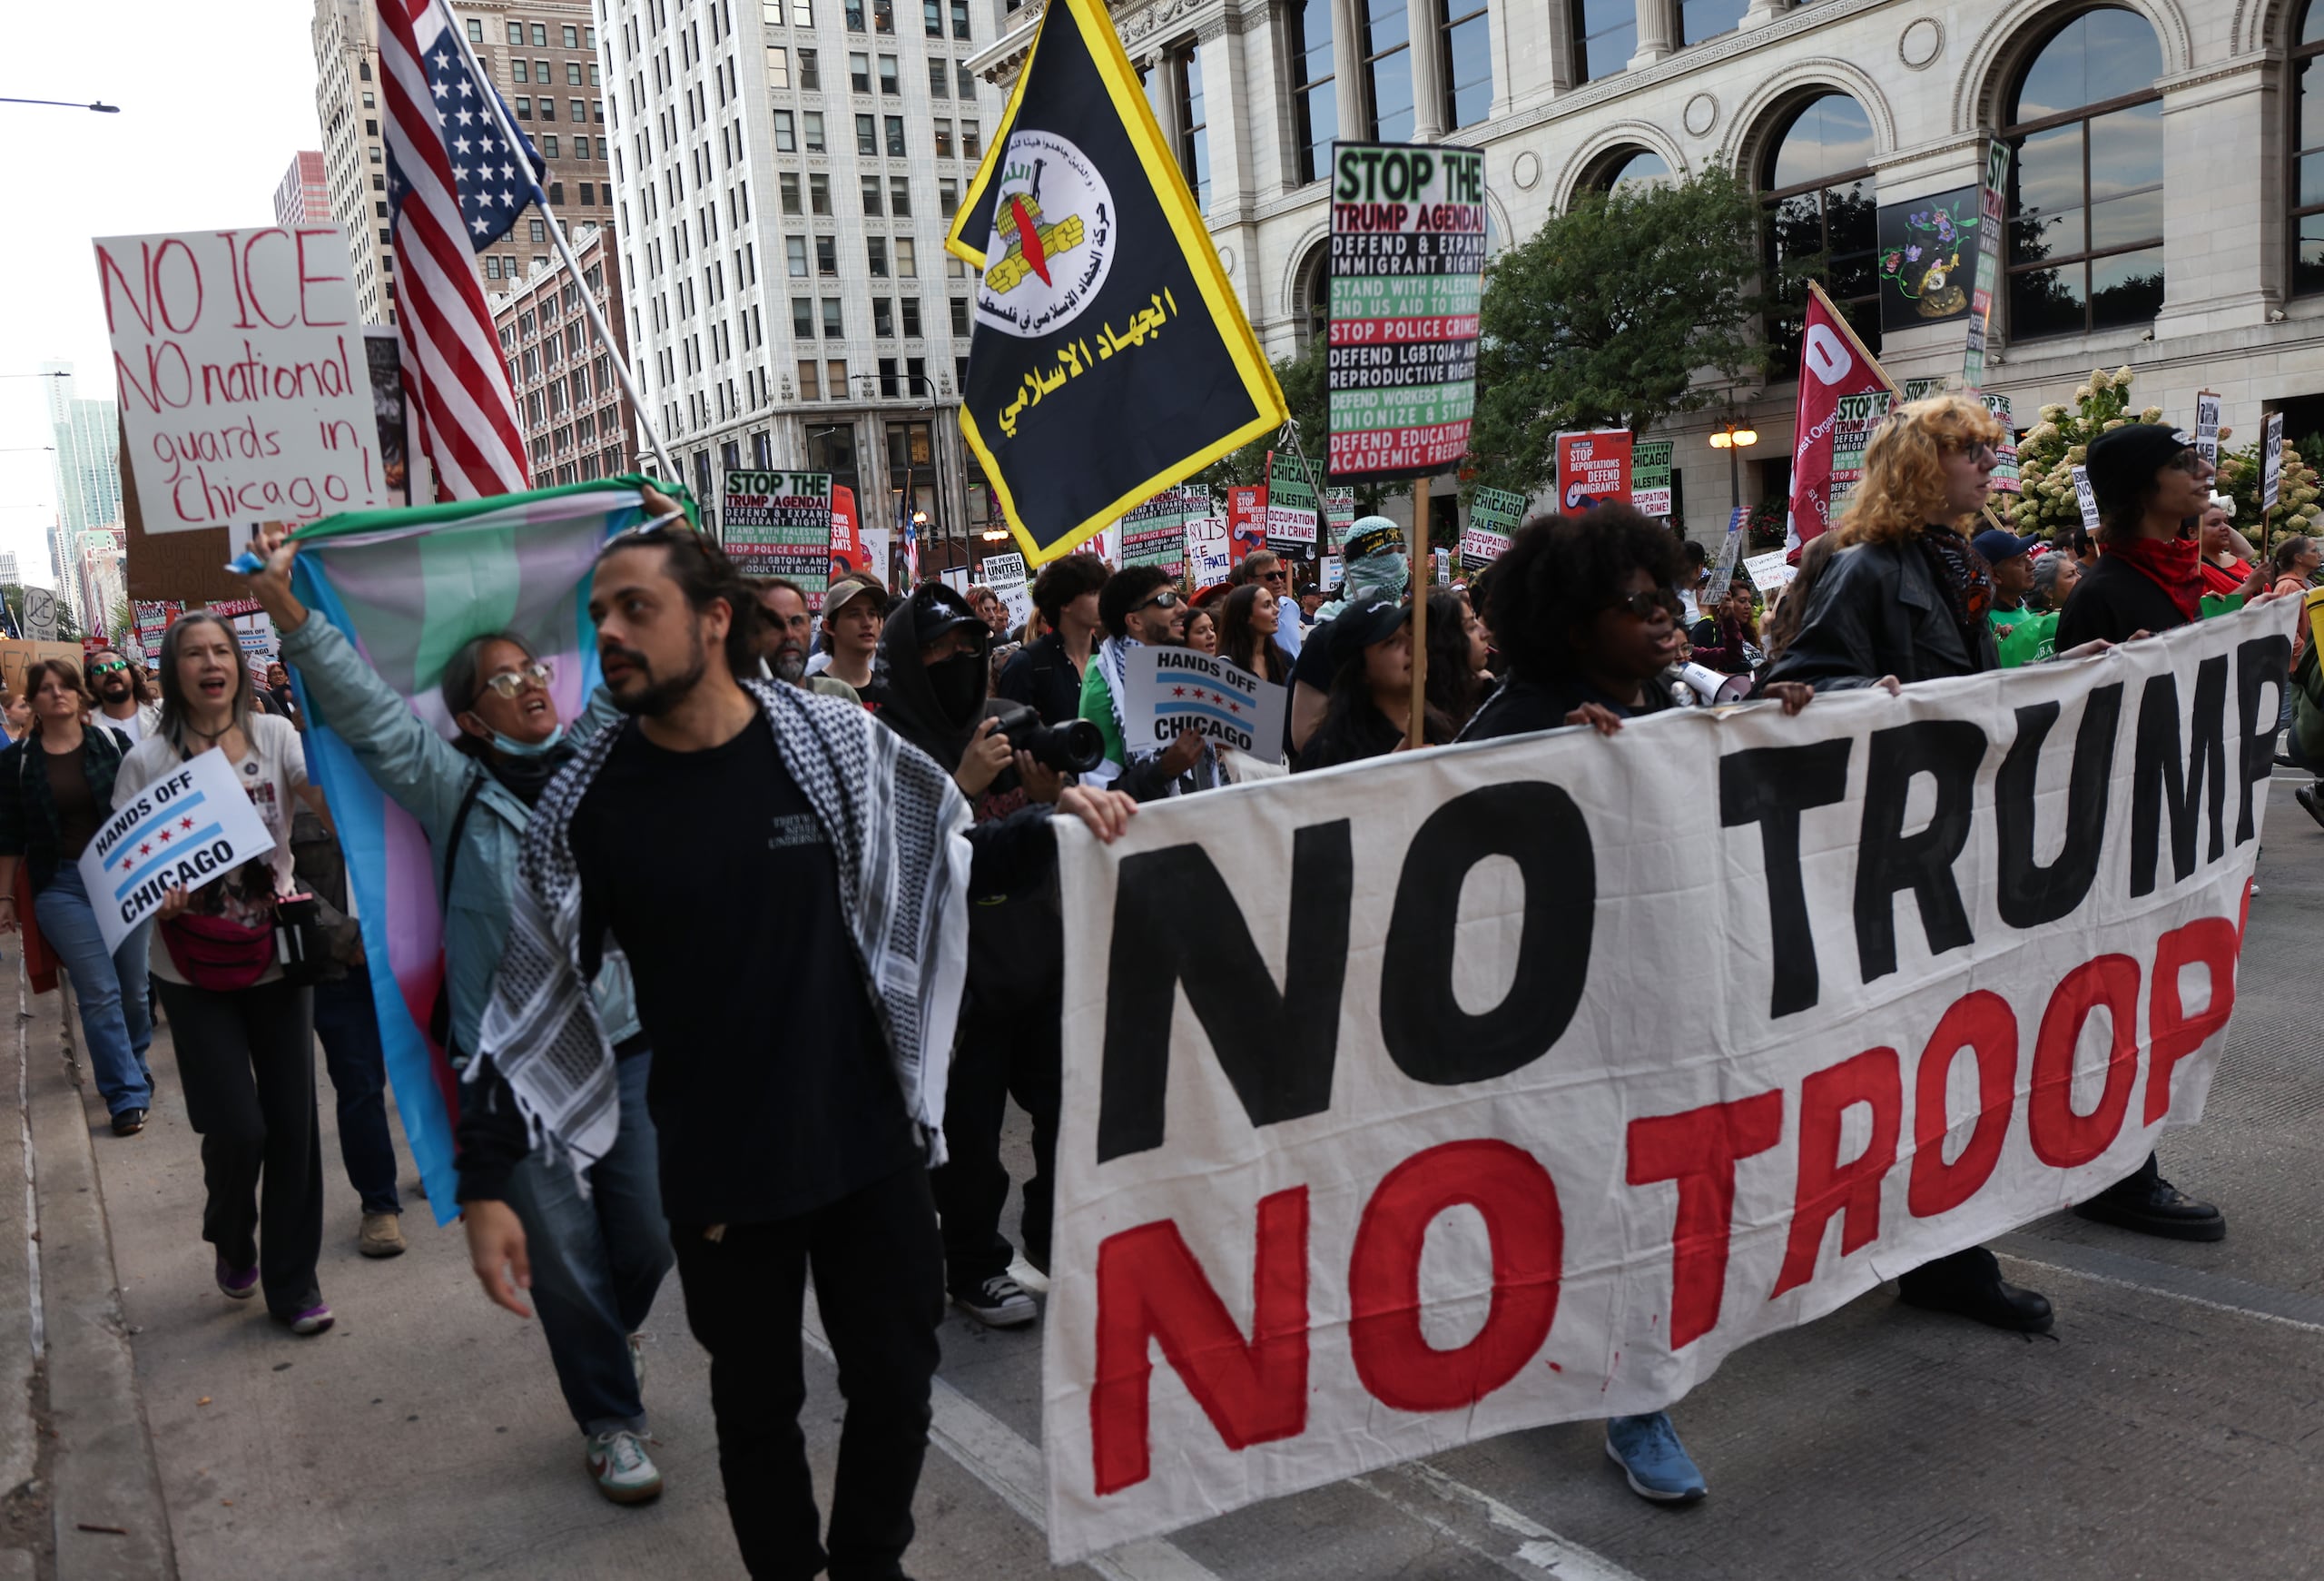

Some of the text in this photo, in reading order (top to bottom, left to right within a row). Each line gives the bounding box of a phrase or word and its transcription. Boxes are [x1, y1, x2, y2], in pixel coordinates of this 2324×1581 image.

[1336, 150, 1482, 203] STOP THE
[1091, 203, 1110, 247] حركة
[1334, 203, 1483, 232] TRUMP AGENDA!
[1333, 235, 1485, 255] DEFEND & EXPAND
[1332, 256, 1484, 275] IMMIGRANT RIGHTS
[96, 228, 348, 337] NO ICE
[1333, 278, 1426, 298] STAND WITH
[1333, 298, 1446, 317] END US AID TO
[1097, 286, 1177, 361] الجهاد
[1331, 322, 1374, 342] STOP
[1384, 320, 1440, 340] POLICE
[1330, 341, 1477, 368] DEFEND LGBTQIA+ AND
[113, 334, 354, 414] NO national
[1330, 361, 1475, 389] REPRODUCTIVE RIGHTS
[1904, 380, 1928, 402] STOP
[1330, 391, 1378, 410] DEFEND
[1837, 393, 1888, 421] STOP THE
[1999, 398, 2011, 414] THE
[1330, 408, 1416, 430] UNIONIZE
[1426, 407, 1434, 423] &
[1836, 420, 1865, 434] TRUMP
[153, 407, 359, 484] guards in
[1330, 425, 1464, 454] DEFEND EDUCATION
[1834, 434, 1865, 443] DEFEND
[1571, 450, 1593, 462] STOP
[1834, 452, 1856, 461] STAND
[2267, 437, 2281, 460] NO
[1330, 448, 1421, 473] ACADEMIC
[1571, 459, 1620, 472] DEPORTATIONS
[1833, 459, 1856, 469] END US
[1588, 469, 1620, 483] DEFEND
[1633, 474, 1669, 489] ALESTINE
[1832, 471, 1849, 480] STOP
[728, 472, 828, 496] STOP THE
[1189, 485, 1207, 497] THE
[1571, 481, 1620, 496] IMMIGRANTS
[2076, 482, 2093, 498] NO
[1270, 490, 1316, 509] PALESTINE
[1326, 488, 1353, 499] STOP THE
[1633, 491, 1669, 504] CCUPATION
[727, 495, 828, 509] TRUMP AGENDA!
[1157, 500, 1182, 510] EXPAND
[1236, 497, 1256, 507] STOP
[1237, 506, 1265, 514] DEPORTATI
[1473, 493, 1522, 517] CHICAGO
[1646, 503, 1669, 514] CRIME!
[726, 509, 831, 519] DEFEND & EXPAND
[1123, 506, 1182, 523] IMMIGRANT RIGHTS
[1268, 510, 1315, 526] OCCUPATION
[725, 518, 786, 527] IMMIGRANT
[793, 519, 831, 527] RIGHTS
[1237, 522, 1265, 531] IMMIGRA
[783, 528, 828, 537] PALESTINE
[1123, 537, 1137, 545] STOP
[1139, 532, 1158, 540] POLICE
[1162, 528, 1182, 537] CRIMES
[1268, 524, 1315, 539] IS A CRIME!
[724, 545, 750, 553] STOP
[793, 546, 828, 554] CRIMES
[1123, 543, 1143, 552] DEFEND
[1123, 547, 1161, 558] REPRODUCTIVE
[1164, 543, 1182, 551] RIGHTS
[1466, 542, 1482, 555] IS A
[809, 557, 828, 565] AND
[986, 555, 1021, 567] THE PEOPLE
[988, 562, 1022, 576] UNITED
[795, 566, 828, 574] RIGHTS
[1003, 571, 1024, 580] DEFEND
[1157, 652, 1257, 694] HANDS OFF
[1154, 716, 1253, 751] CHICAGO
[95, 770, 192, 857] HANDS OFF
[120, 840, 234, 924] CHICAGO
[1097, 634, 2292, 1165] NO TRUMP
[1091, 875, 2255, 1497] NO TROOP
